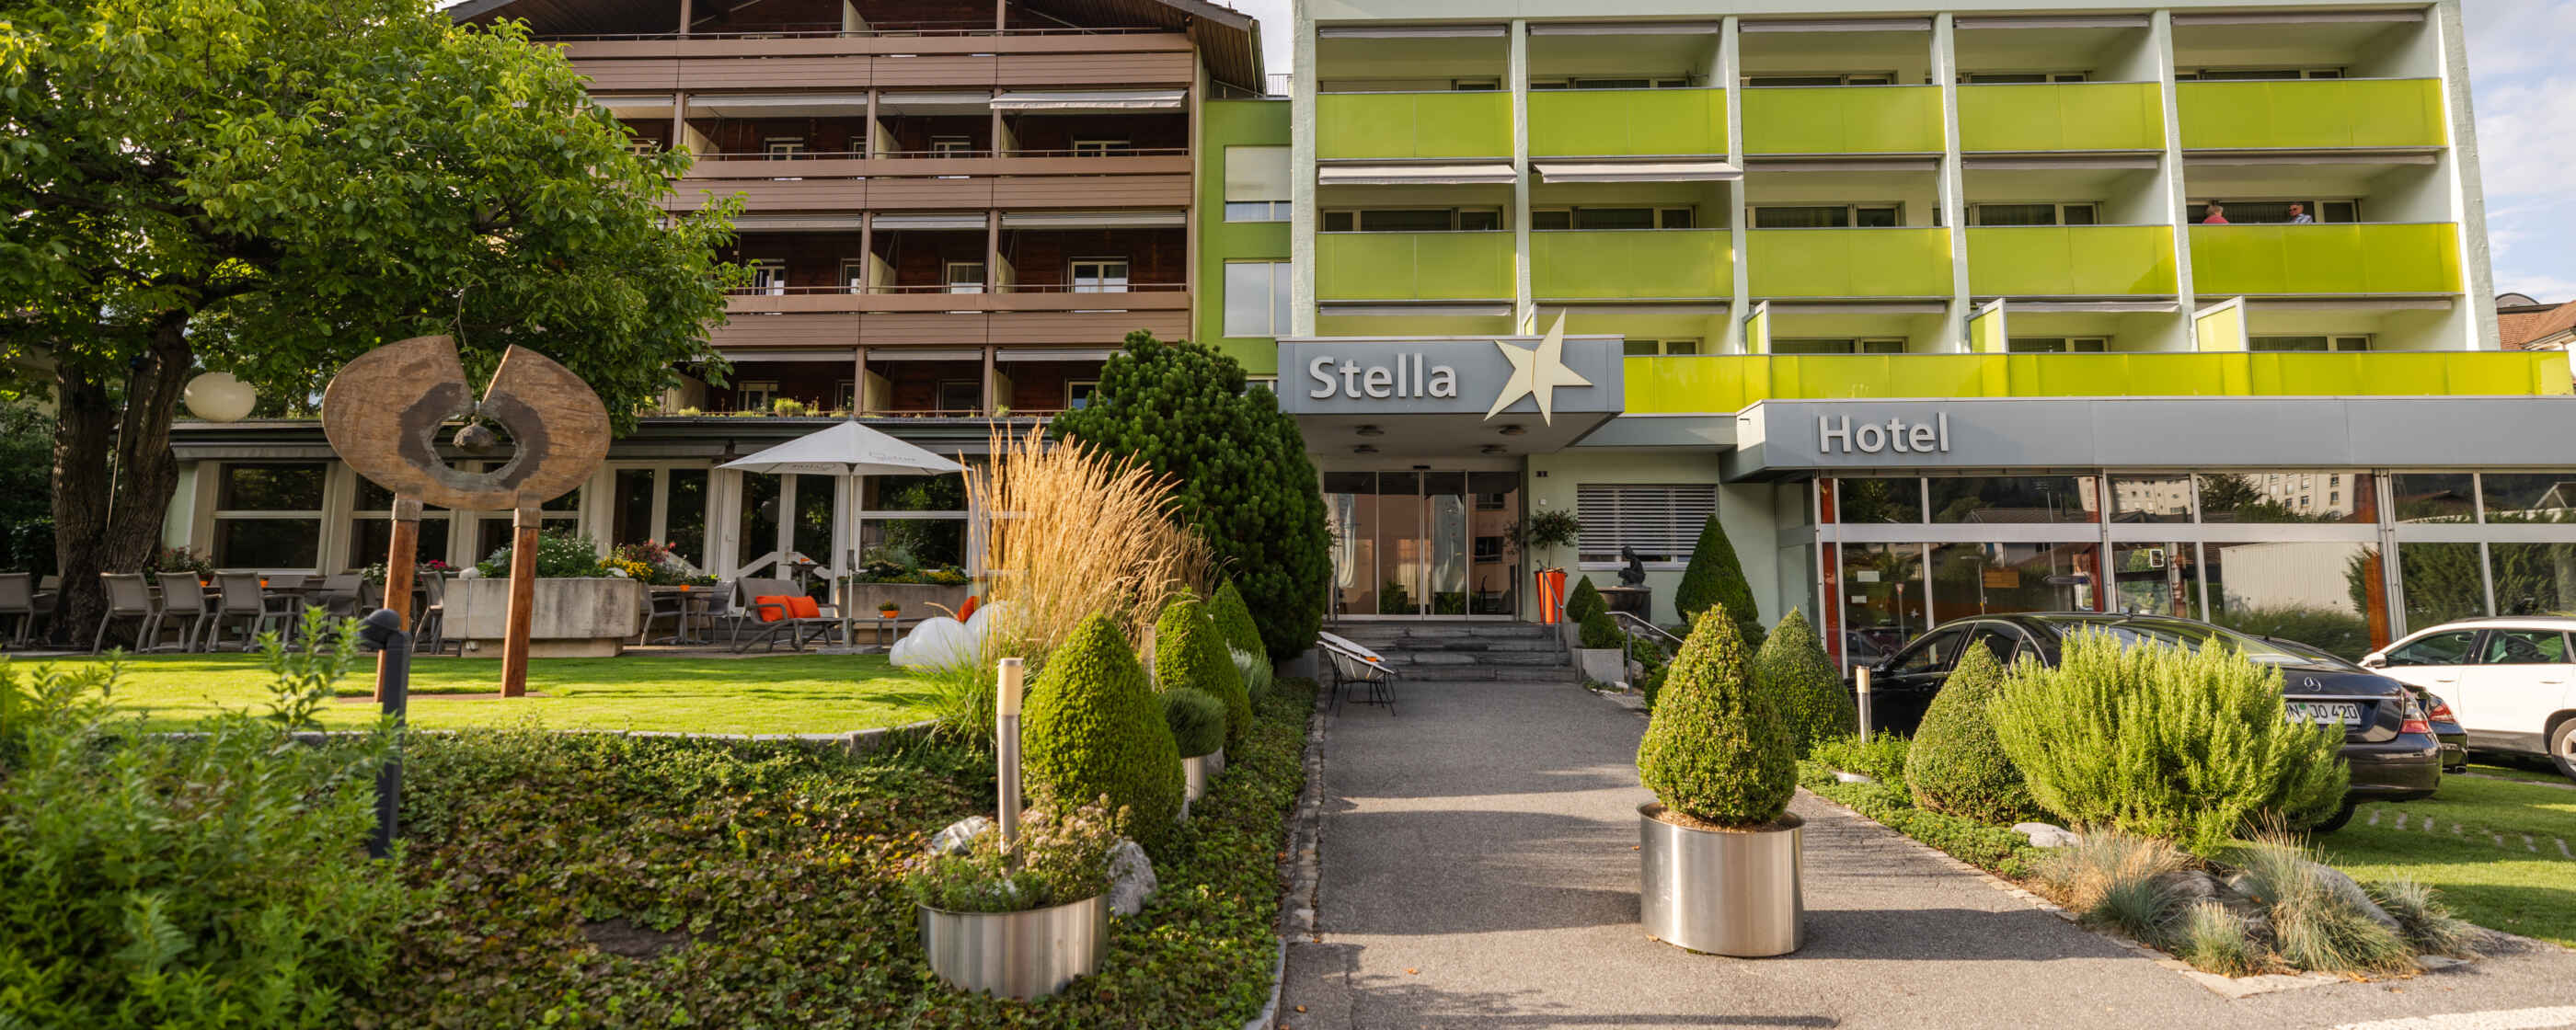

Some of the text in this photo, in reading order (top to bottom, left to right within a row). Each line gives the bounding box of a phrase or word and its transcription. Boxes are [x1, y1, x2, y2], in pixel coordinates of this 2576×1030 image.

[1309, 352, 1457, 398] Stella
[1818, 411, 1949, 453] Hotel
[2331, 704, 2359, 719] 420
